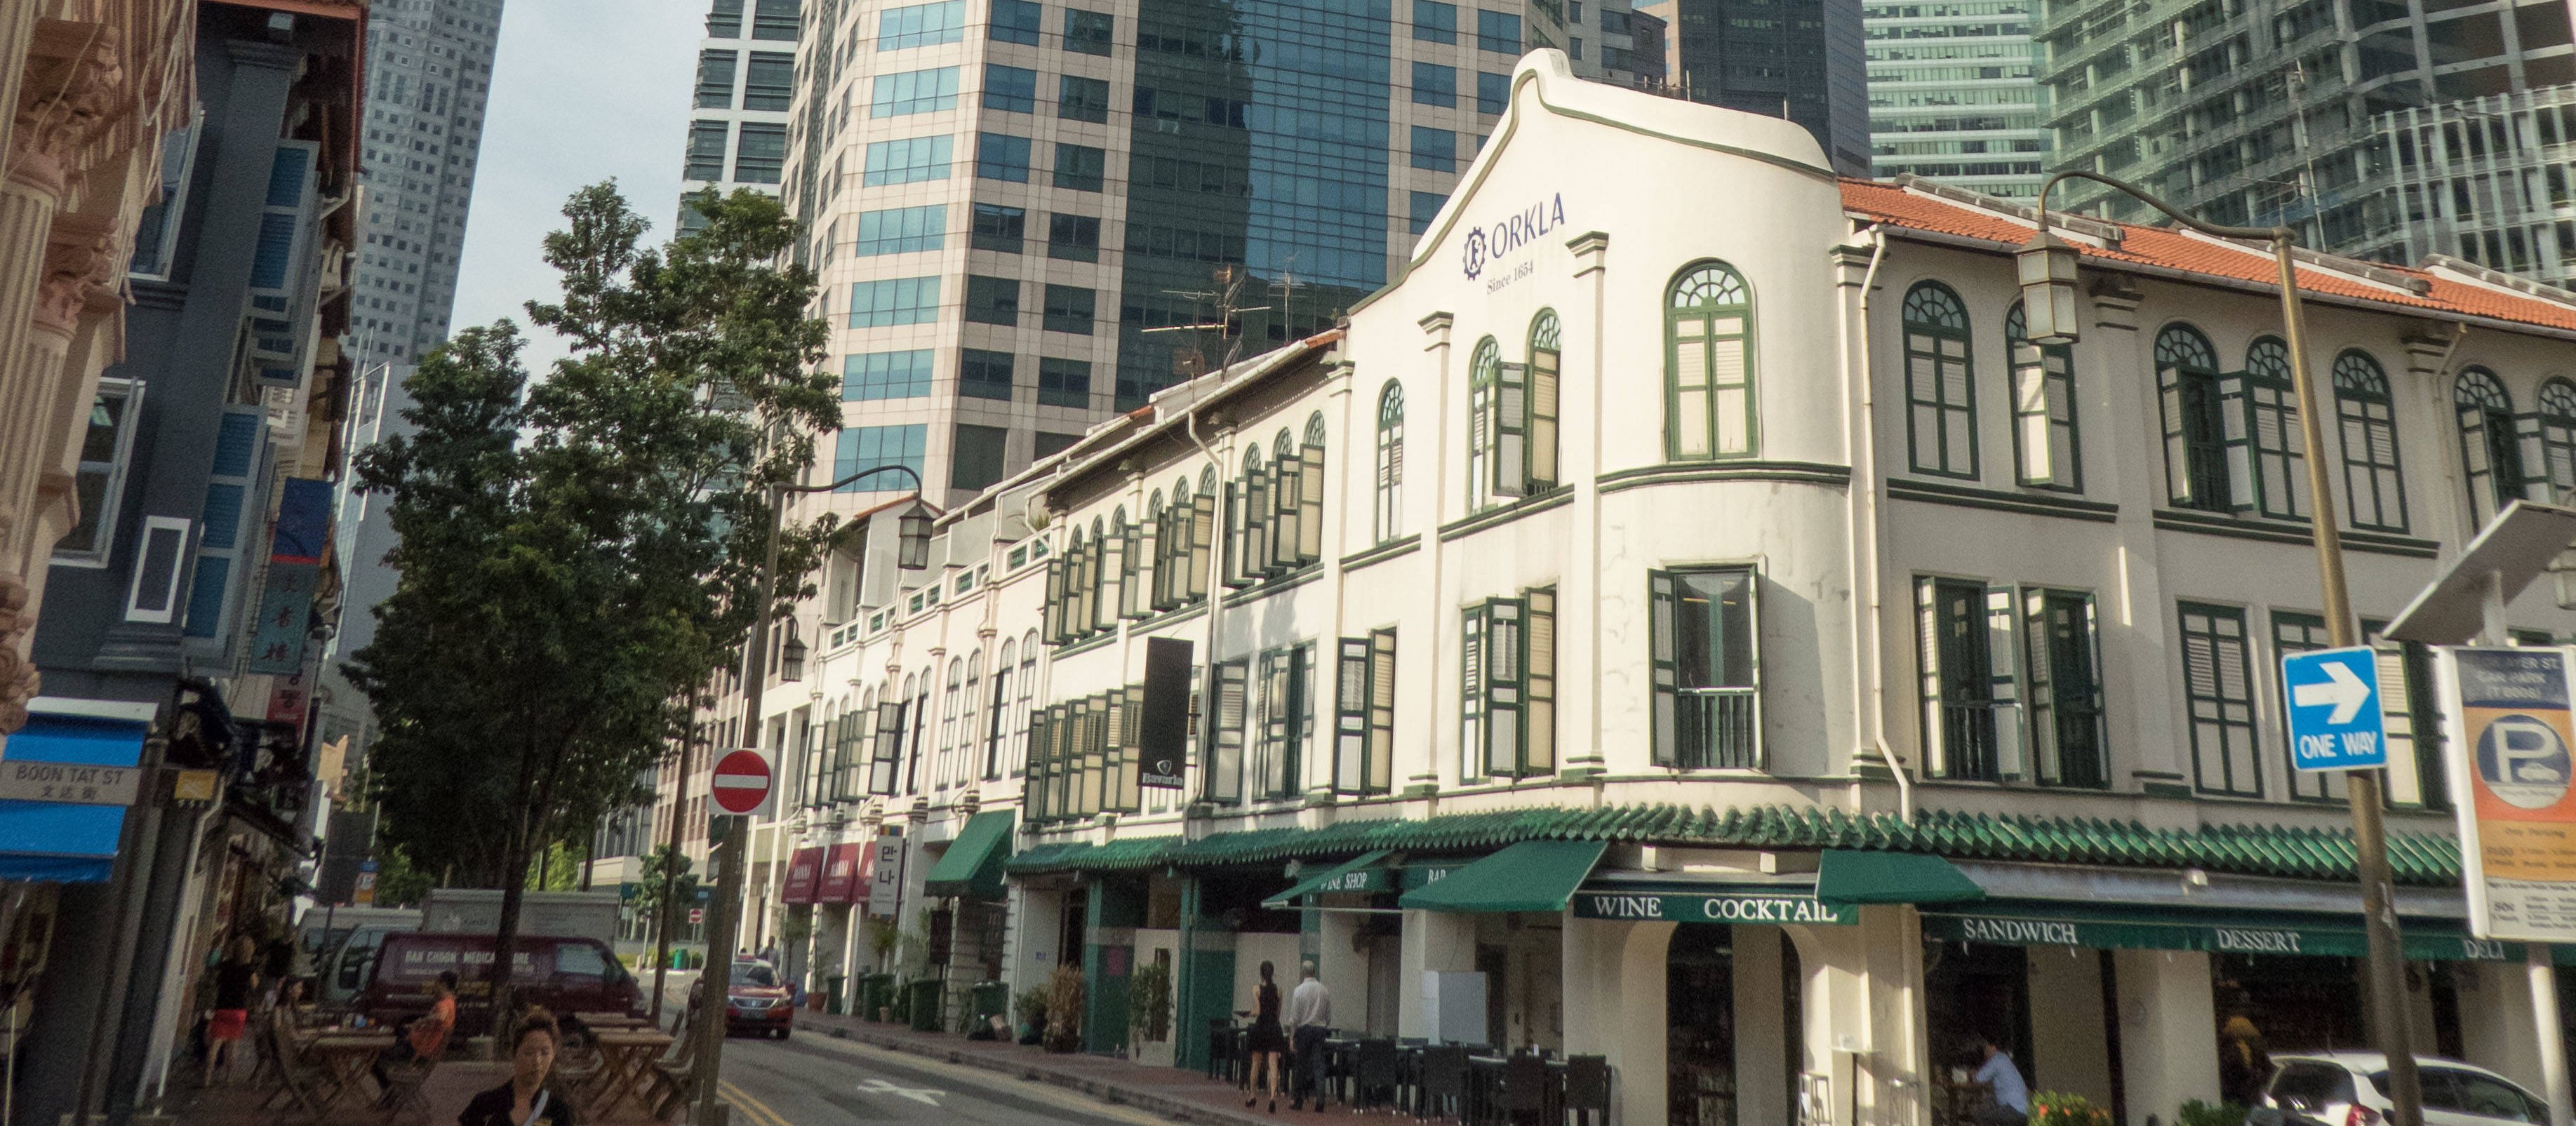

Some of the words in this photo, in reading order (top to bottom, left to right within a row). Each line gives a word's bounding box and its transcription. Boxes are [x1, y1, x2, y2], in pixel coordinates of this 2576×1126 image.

[1493, 192, 1565, 259] ORKLA
[1487, 274, 1511, 295] Since
[1514, 260, 1533, 281] 1654
[2300, 734, 2337, 759] ONE
[2340, 730, 2377, 756] WAY
[16, 765, 62, 782] BOON
[69, 768, 100, 783] TAT
[103, 770, 124, 785] ST
[1142, 772, 1183, 786] Bavaria
[879, 846, 897, 885] 만나
[1344, 871, 1368, 890] SHOP
[1594, 897, 1662, 918] WINE
[1704, 897, 1838, 922] COCKTAIL
[1963, 918, 2079, 945] SANDWICH
[2217, 928, 2302, 953] DESSERT
[2464, 939, 2507, 960] DELI
